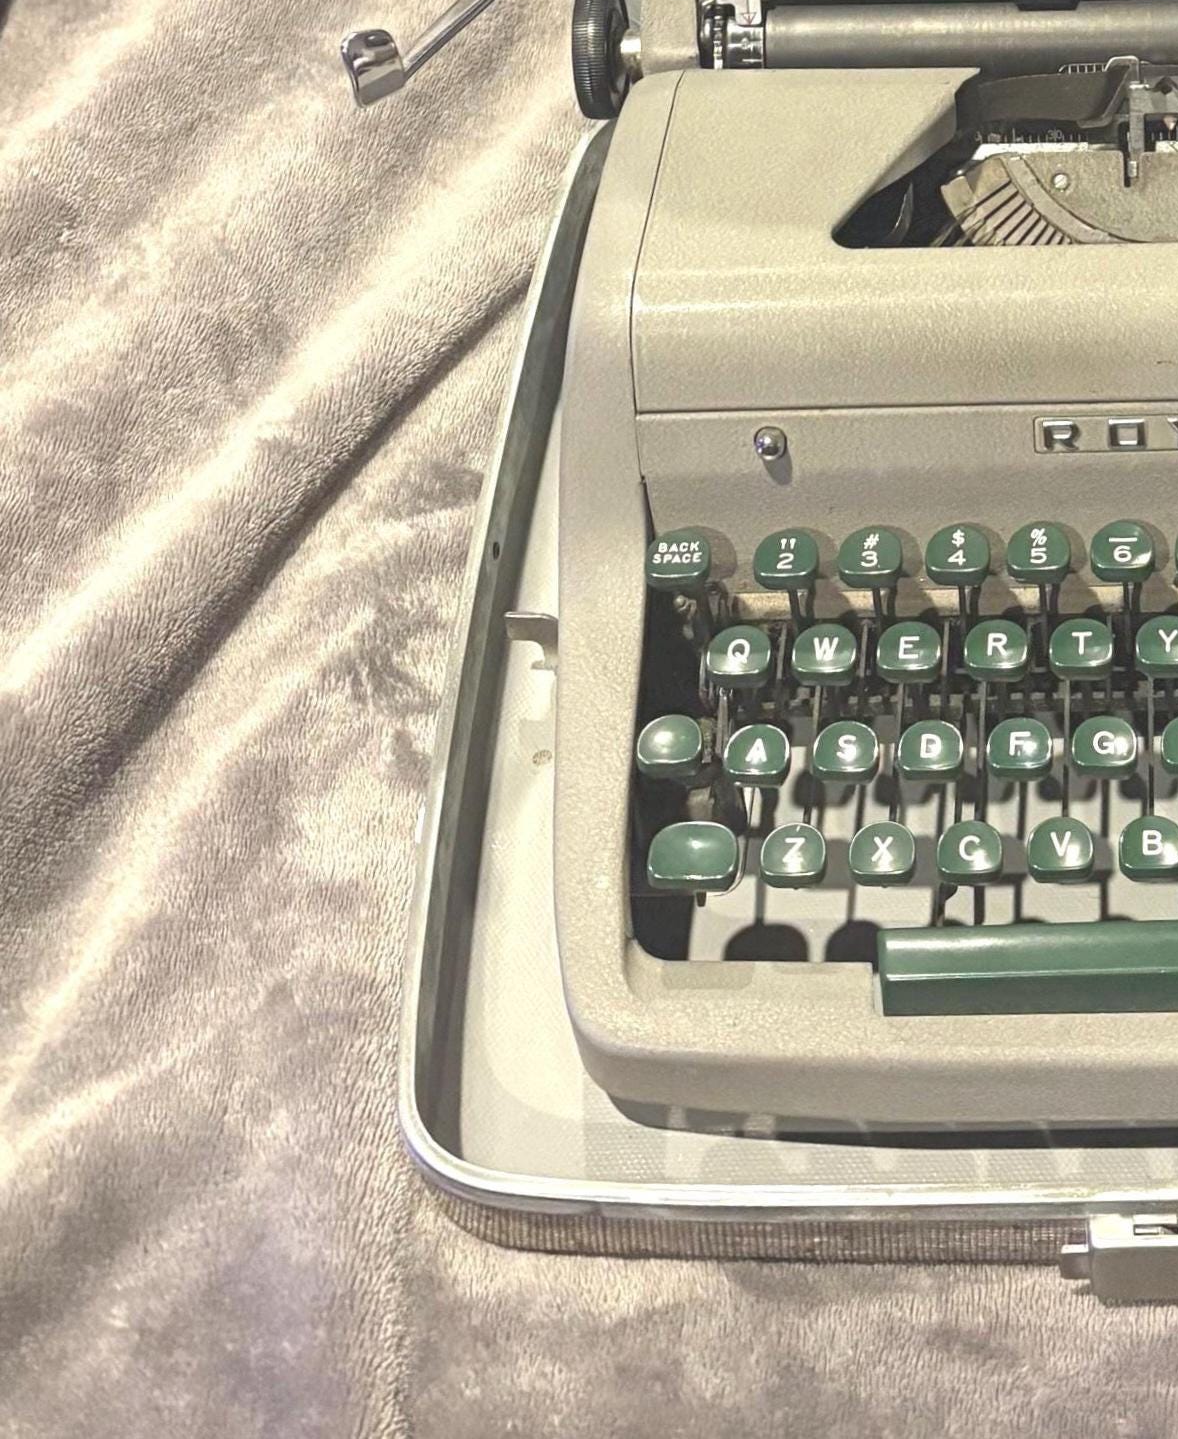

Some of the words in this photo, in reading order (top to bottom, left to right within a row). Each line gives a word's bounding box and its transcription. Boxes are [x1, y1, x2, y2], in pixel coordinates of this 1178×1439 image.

[658, 541, 700, 553] BACK
[864, 534, 879, 548] #
[952, 529, 964, 547] $
[1030, 528, 1046, 545] %
[652, 552, 702, 564] SPACE
[777, 553, 792, 569] 2
[861, 552, 878, 567] 3
[948, 550, 966, 565] 4
[1031, 548, 1046, 563] 5
[1114, 545, 1131, 561] 6
[727, 639, 750, 663] Q
[812, 637, 840, 660] W
[898, 636, 920, 658] E
[987, 633, 1008, 656] R
[1072, 632, 1093, 654] T
[1158, 629, 1178, 653] Y
[745, 738, 767, 762] A
[837, 736, 856, 760] S
[920, 734, 941, 758] D
[1009, 731, 1031, 755] F
[1093, 731, 1115, 754] G
[784, 837, 806, 861] Z
[871, 836, 893, 861] X
[958, 835, 980, 859] C
[1051, 833, 1071, 857] V
[1143, 832, 1162, 856] B
